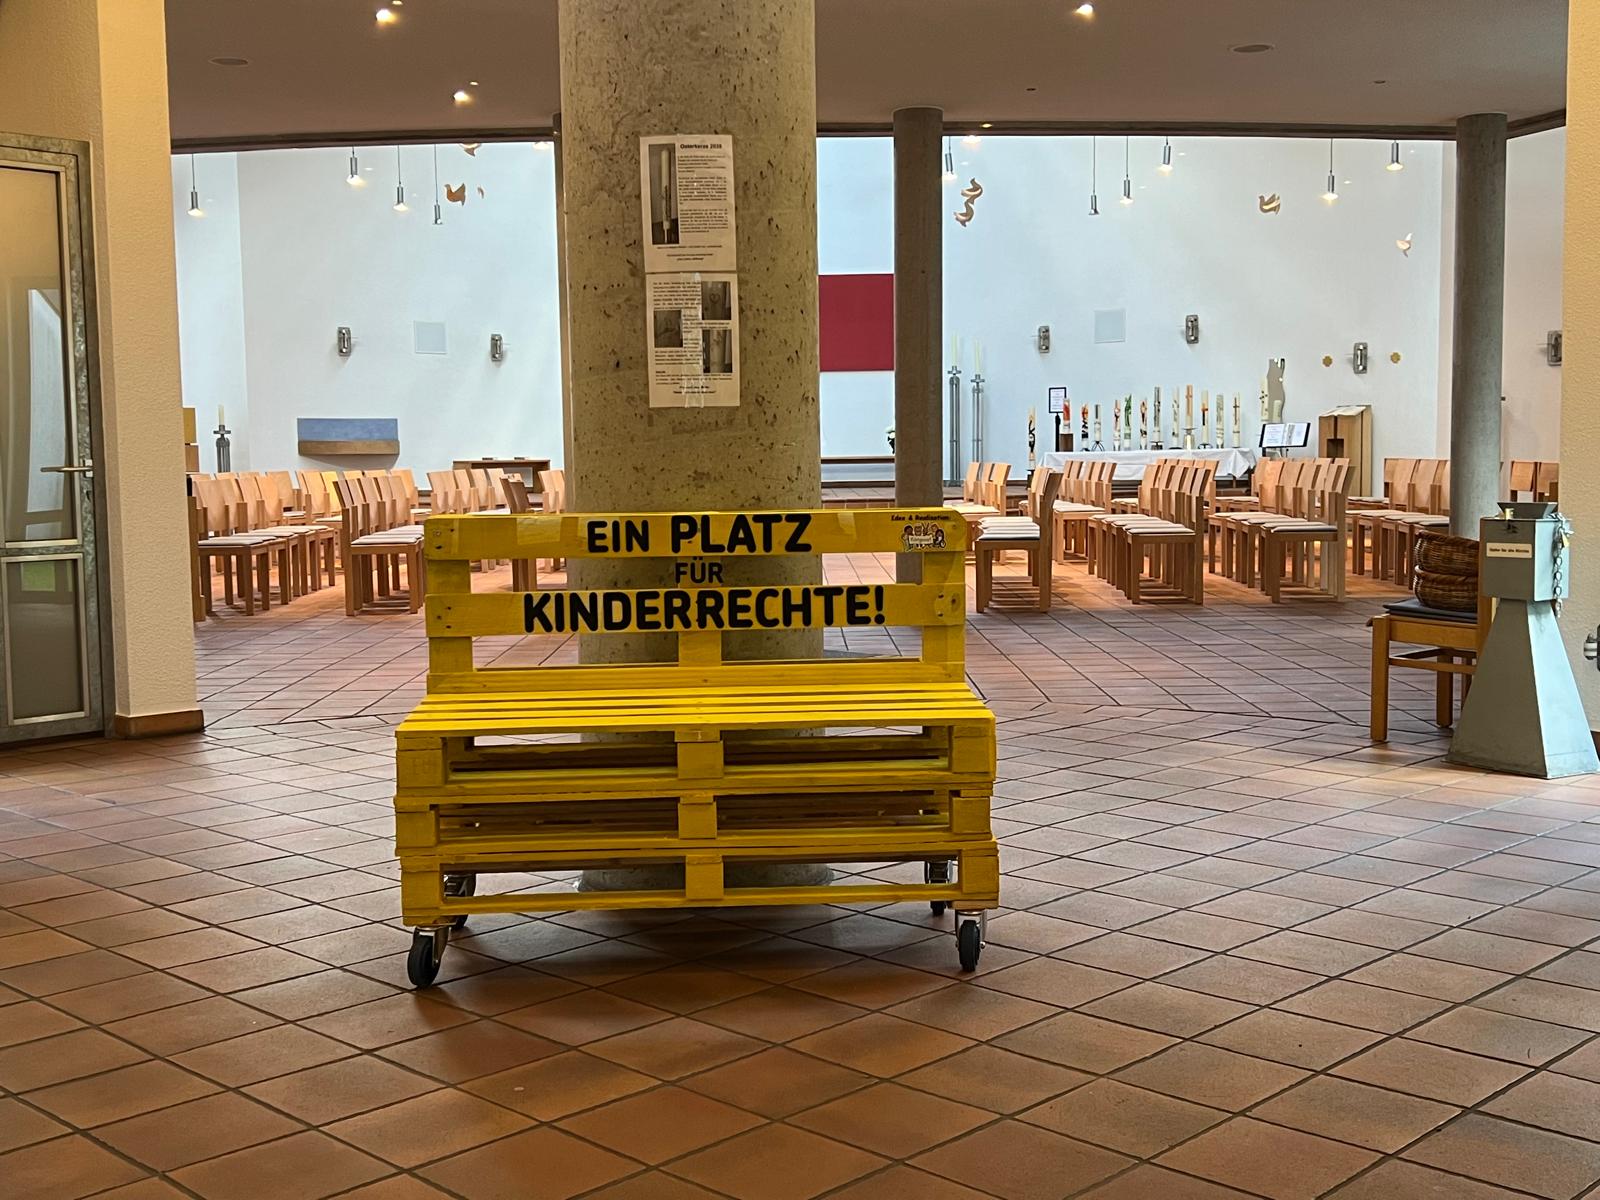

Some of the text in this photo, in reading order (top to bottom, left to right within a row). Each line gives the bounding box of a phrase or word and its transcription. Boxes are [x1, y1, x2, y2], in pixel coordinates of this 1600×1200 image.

[587, 515, 812, 553] EIN PLATZ
[675, 556, 723, 584] FÜR
[524, 586, 885, 633] KINDERRECHTE!
